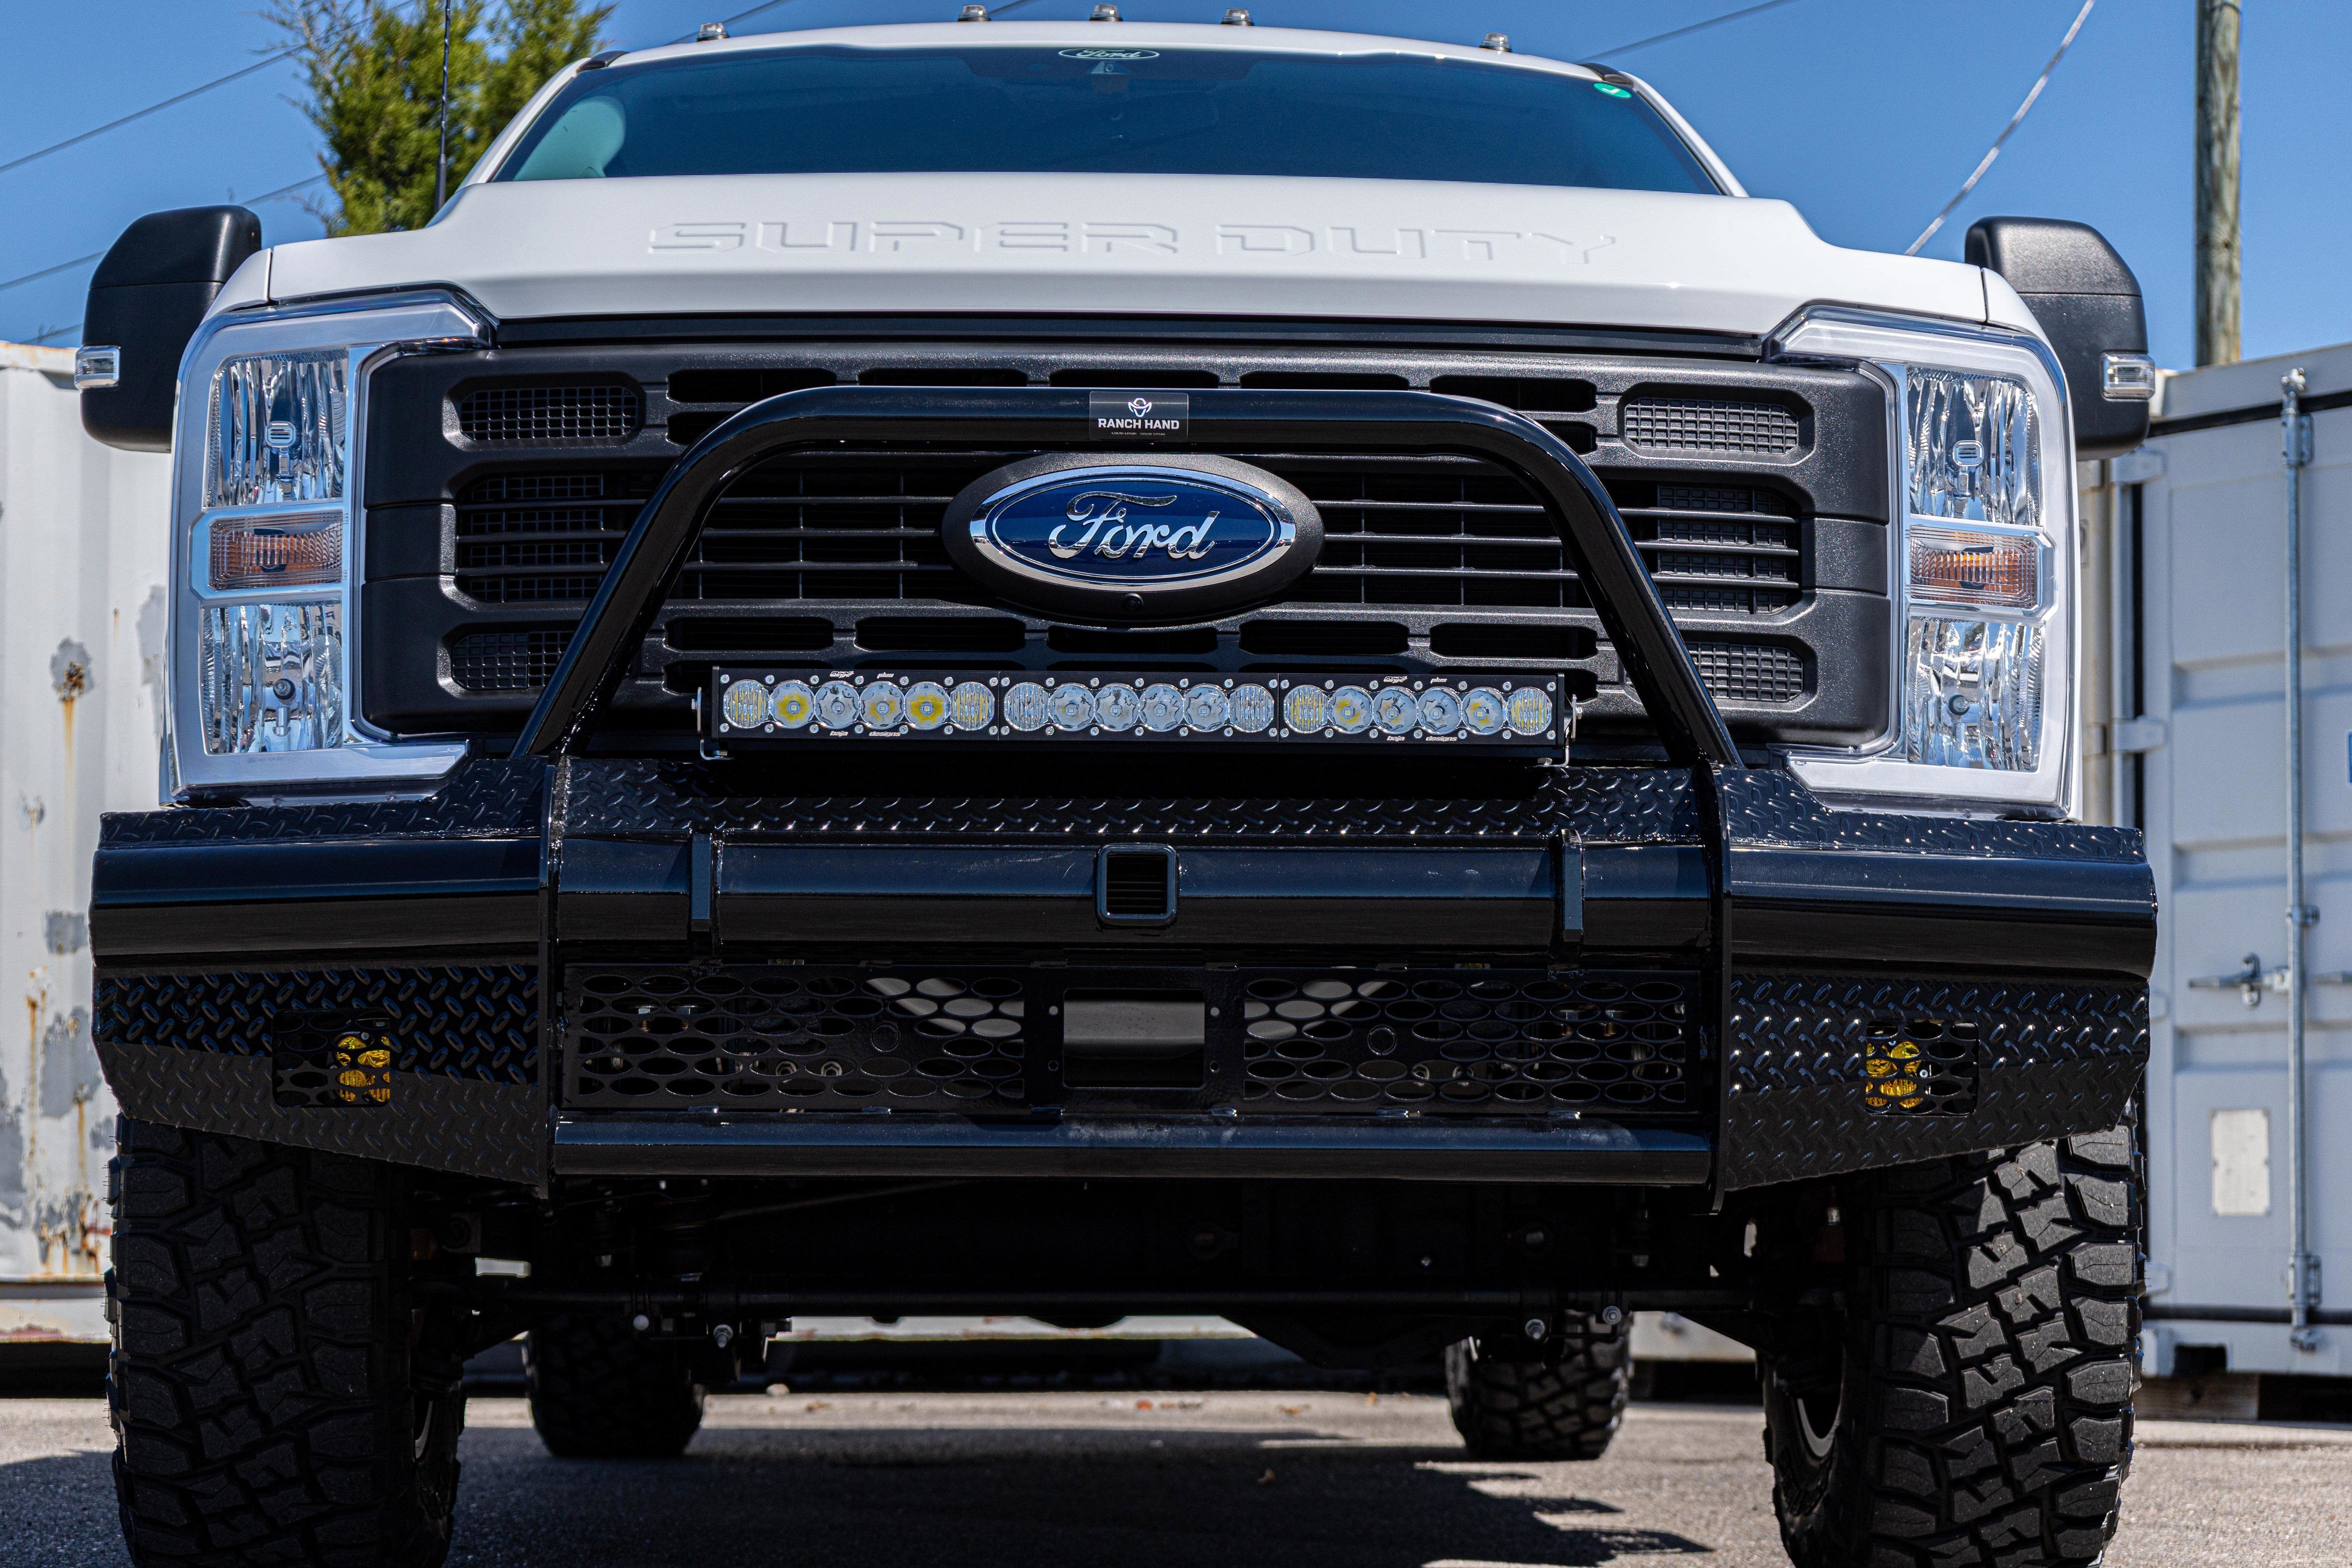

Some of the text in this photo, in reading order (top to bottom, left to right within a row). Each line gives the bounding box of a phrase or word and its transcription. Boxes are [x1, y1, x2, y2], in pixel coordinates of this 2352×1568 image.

[1076, 49, 1141, 58] Ford
[648, 223, 1616, 265] SUPER DUTY
[1098, 418, 1179, 429] RANCH HAND
[1049, 491, 1220, 559] Ford
